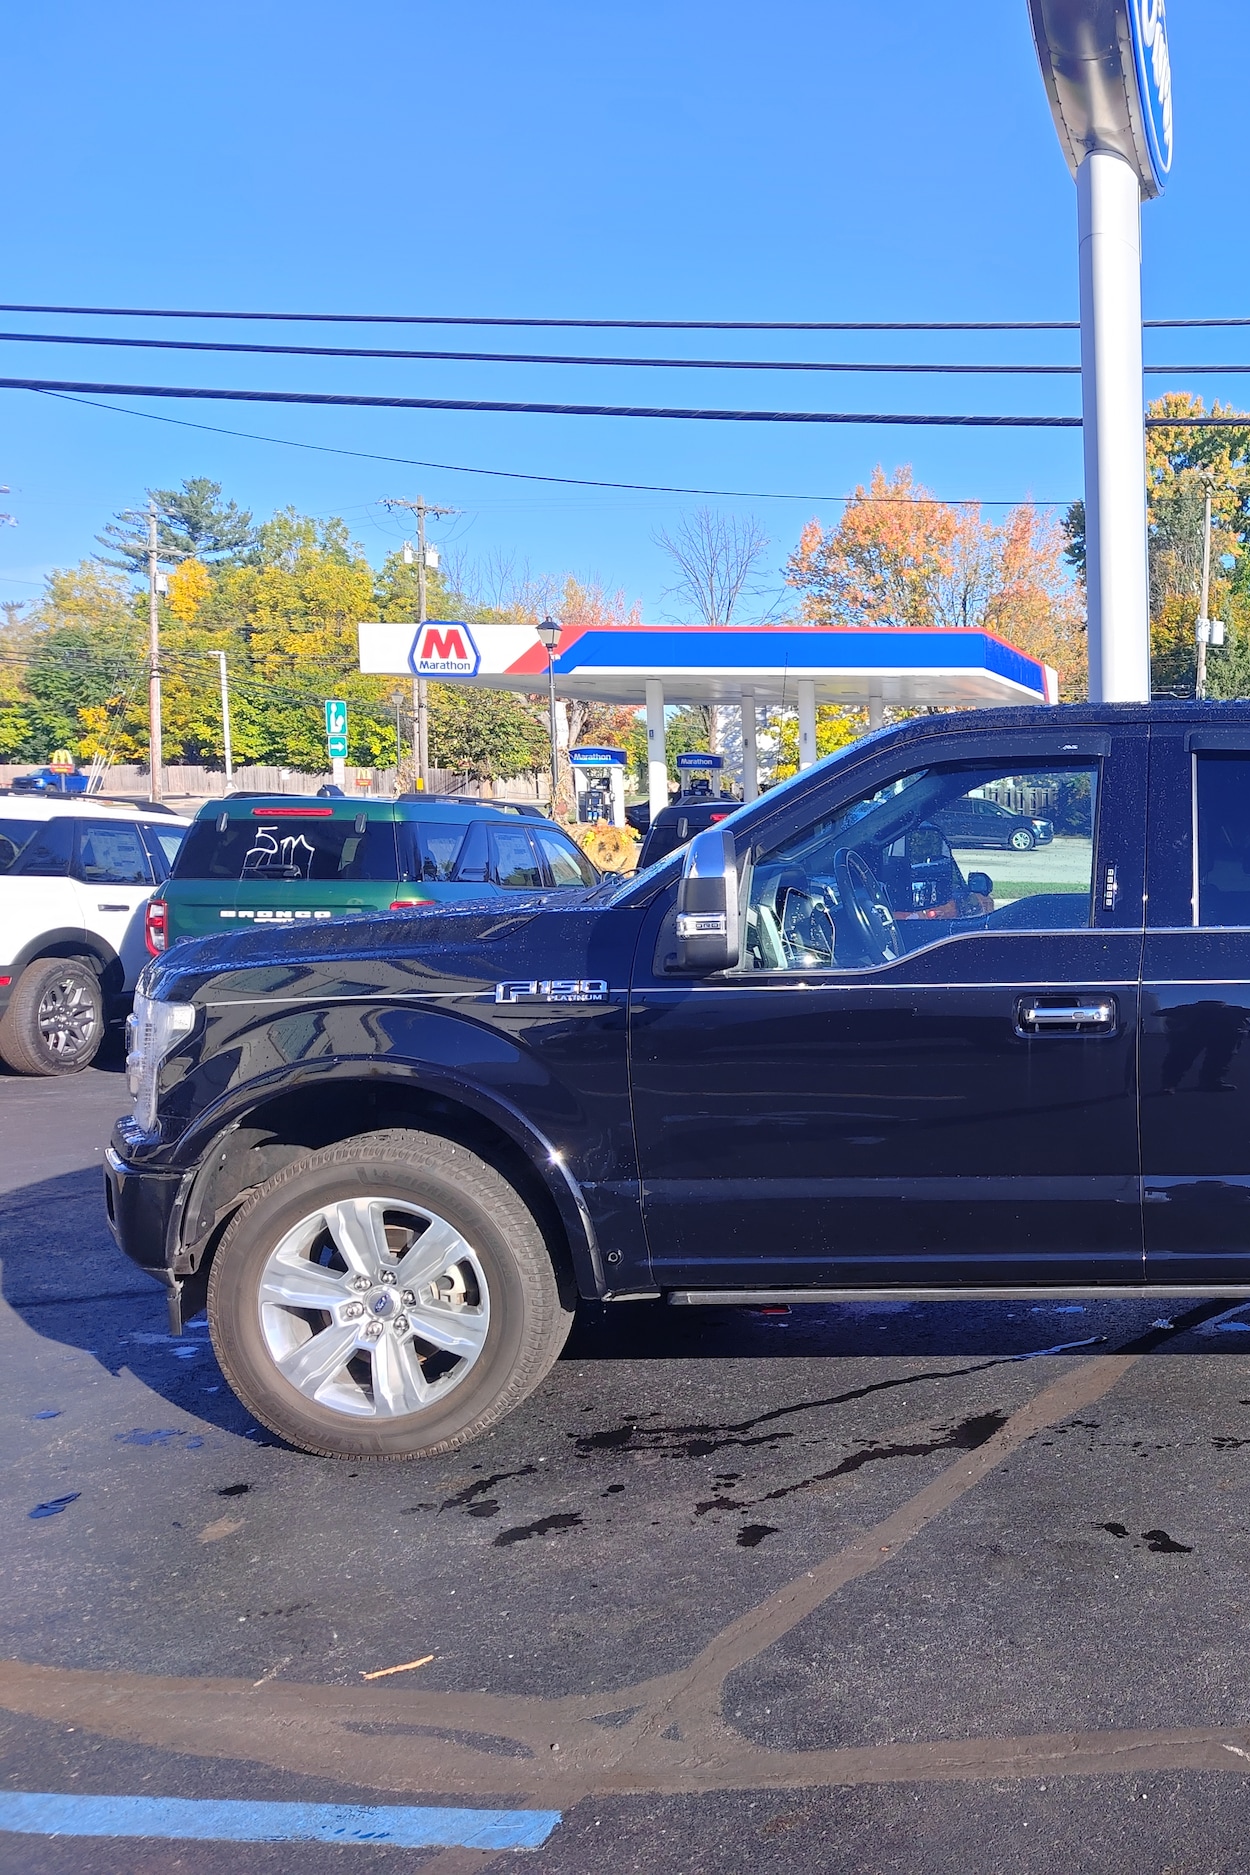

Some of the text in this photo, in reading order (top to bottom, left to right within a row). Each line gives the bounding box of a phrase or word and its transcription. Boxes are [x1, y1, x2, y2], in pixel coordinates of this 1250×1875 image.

[419, 660, 471, 670] Marathon
[573, 753, 612, 761] Marathon
[547, 994, 602, 1002] PLATINUM
